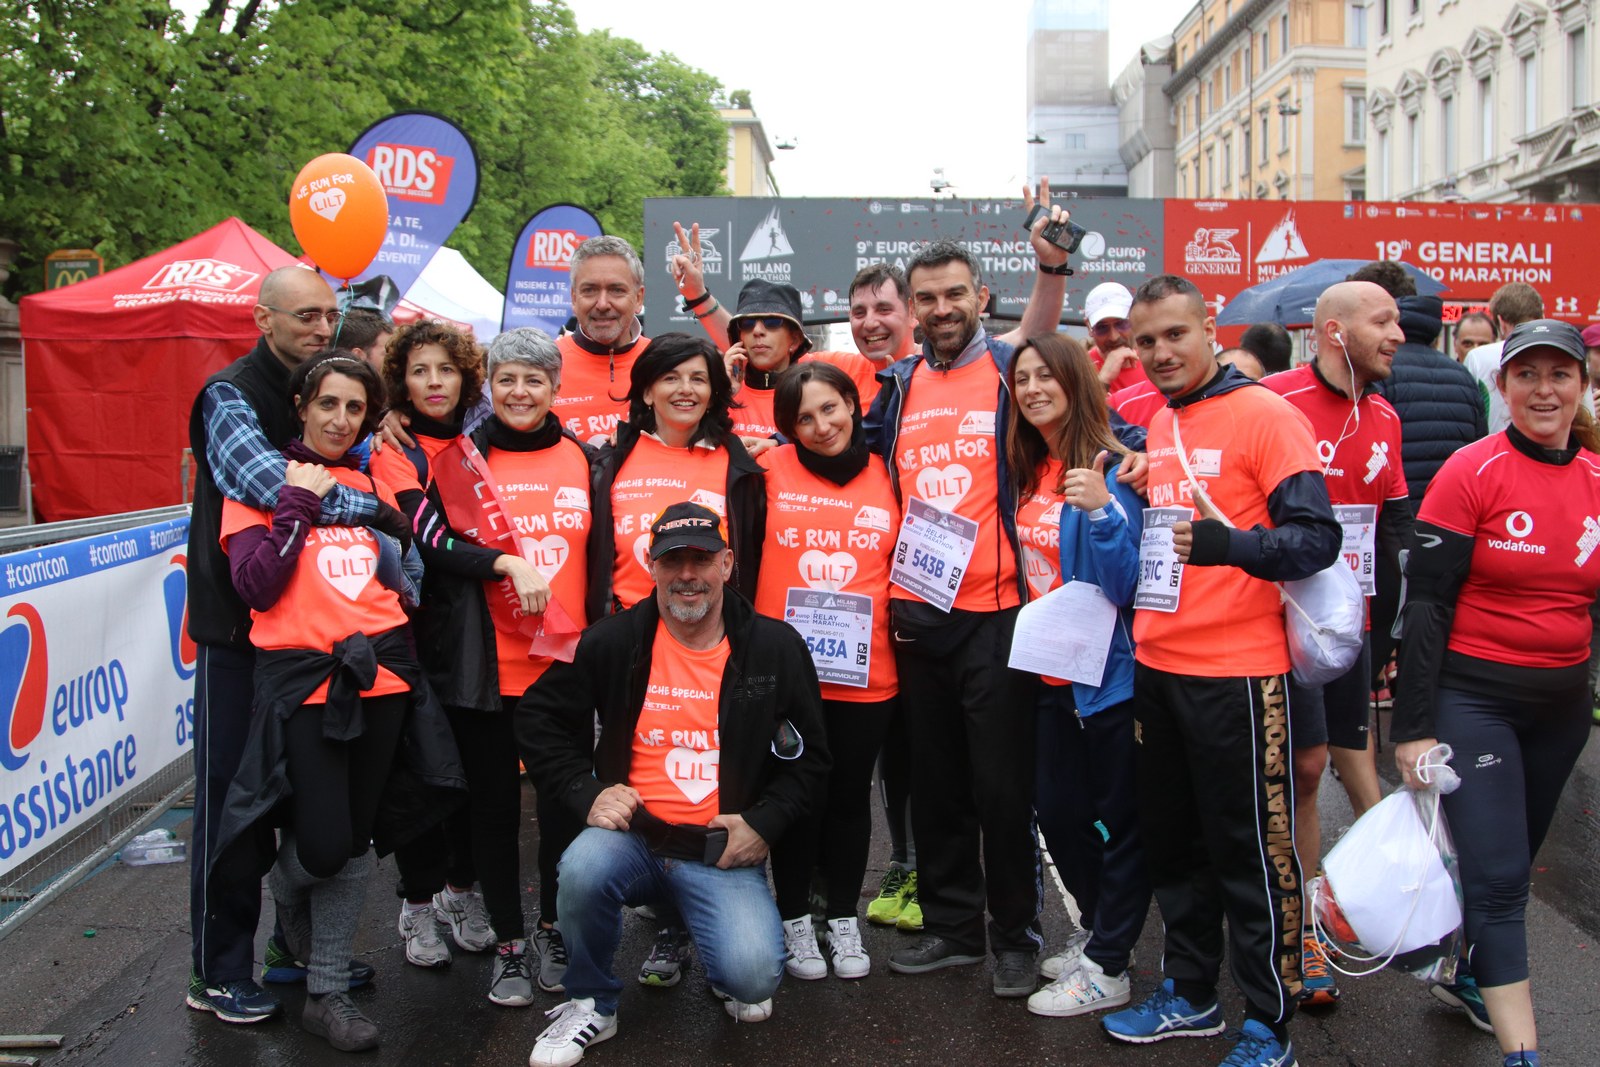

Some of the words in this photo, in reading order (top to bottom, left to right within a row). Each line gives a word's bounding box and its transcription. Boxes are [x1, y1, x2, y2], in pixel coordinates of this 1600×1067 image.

[373, 146, 436, 191] RDS
[296, 185, 309, 199] WE
[309, 177, 330, 192] RUN
[331, 173, 355, 184] FOR
[314, 195, 342, 211] LILT
[393, 216, 402, 227] A
[400, 232, 430, 249] DI...
[534, 231, 577, 262] RDS
[876, 242, 920, 254] EURO
[379, 251, 421, 265] EVENTI!
[1108, 246, 1146, 260] europ
[1418, 241, 1552, 264] GENERALI
[161, 261, 232, 286] RDS
[742, 262, 791, 274] MILANO
[1081, 259, 1146, 272] assistance
[1185, 262, 1241, 275] GENERALI
[1258, 264, 1304, 276] MILAN
[1450, 267, 1552, 283] MARATHON
[515, 281, 547, 289] INSIEME
[548, 282, 555, 290] A
[514, 292, 551, 304] VOGLIA
[1000, 296, 1031, 304] GARMI
[921, 407, 958, 419] SPECIALI
[587, 413, 621, 433] RUN
[747, 424, 777, 434] SPECIAL
[899, 449, 918, 470] WE
[920, 442, 951, 465] RUN
[955, 438, 990, 458] FOR
[506, 483, 549, 492] SPECIALI
[614, 479, 643, 490] AMICHE
[645, 478, 687, 489] SPECIALI
[924, 476, 967, 498] LILT
[778, 491, 808, 502] AMICHE
[811, 496, 853, 509] SPECIALI
[1153, 483, 1175, 507] RUN
[780, 502, 818, 512] RETELIT
[513, 513, 549, 535] RUN
[553, 511, 585, 530] FOR
[615, 514, 634, 535] WE
[658, 517, 712, 532] HERTZ
[316, 527, 354, 543] RUN
[776, 527, 800, 548] WE
[806, 528, 841, 548] RUN
[848, 530, 881, 550] FOR
[925, 527, 948, 540] RELAY
[1032, 526, 1060, 548] FOR
[90, 535, 138, 567] #corricon
[1488, 538, 1546, 554] vodafone
[534, 546, 565, 567] ILT
[912, 548, 946, 579] 543B
[1343, 553, 1359, 571] 7D
[6, 552, 69, 589] #corricon
[327, 557, 373, 578] LILT
[807, 563, 853, 583] LILT
[812, 619, 851, 629] MARATHON
[806, 636, 848, 659] 543A
[825, 671, 861, 681] ARMOUR
[52, 658, 129, 737] europ
[672, 687, 714, 700] SPECIALI
[640, 728, 667, 747] WE
[671, 730, 709, 750] RUN
[675, 761, 719, 781] LILT
[0, 734, 137, 860] assistance
[1265, 782, 1297, 891] COMBAT
[1281, 896, 1300, 947] ARE
[1281, 953, 1303, 997] WE
